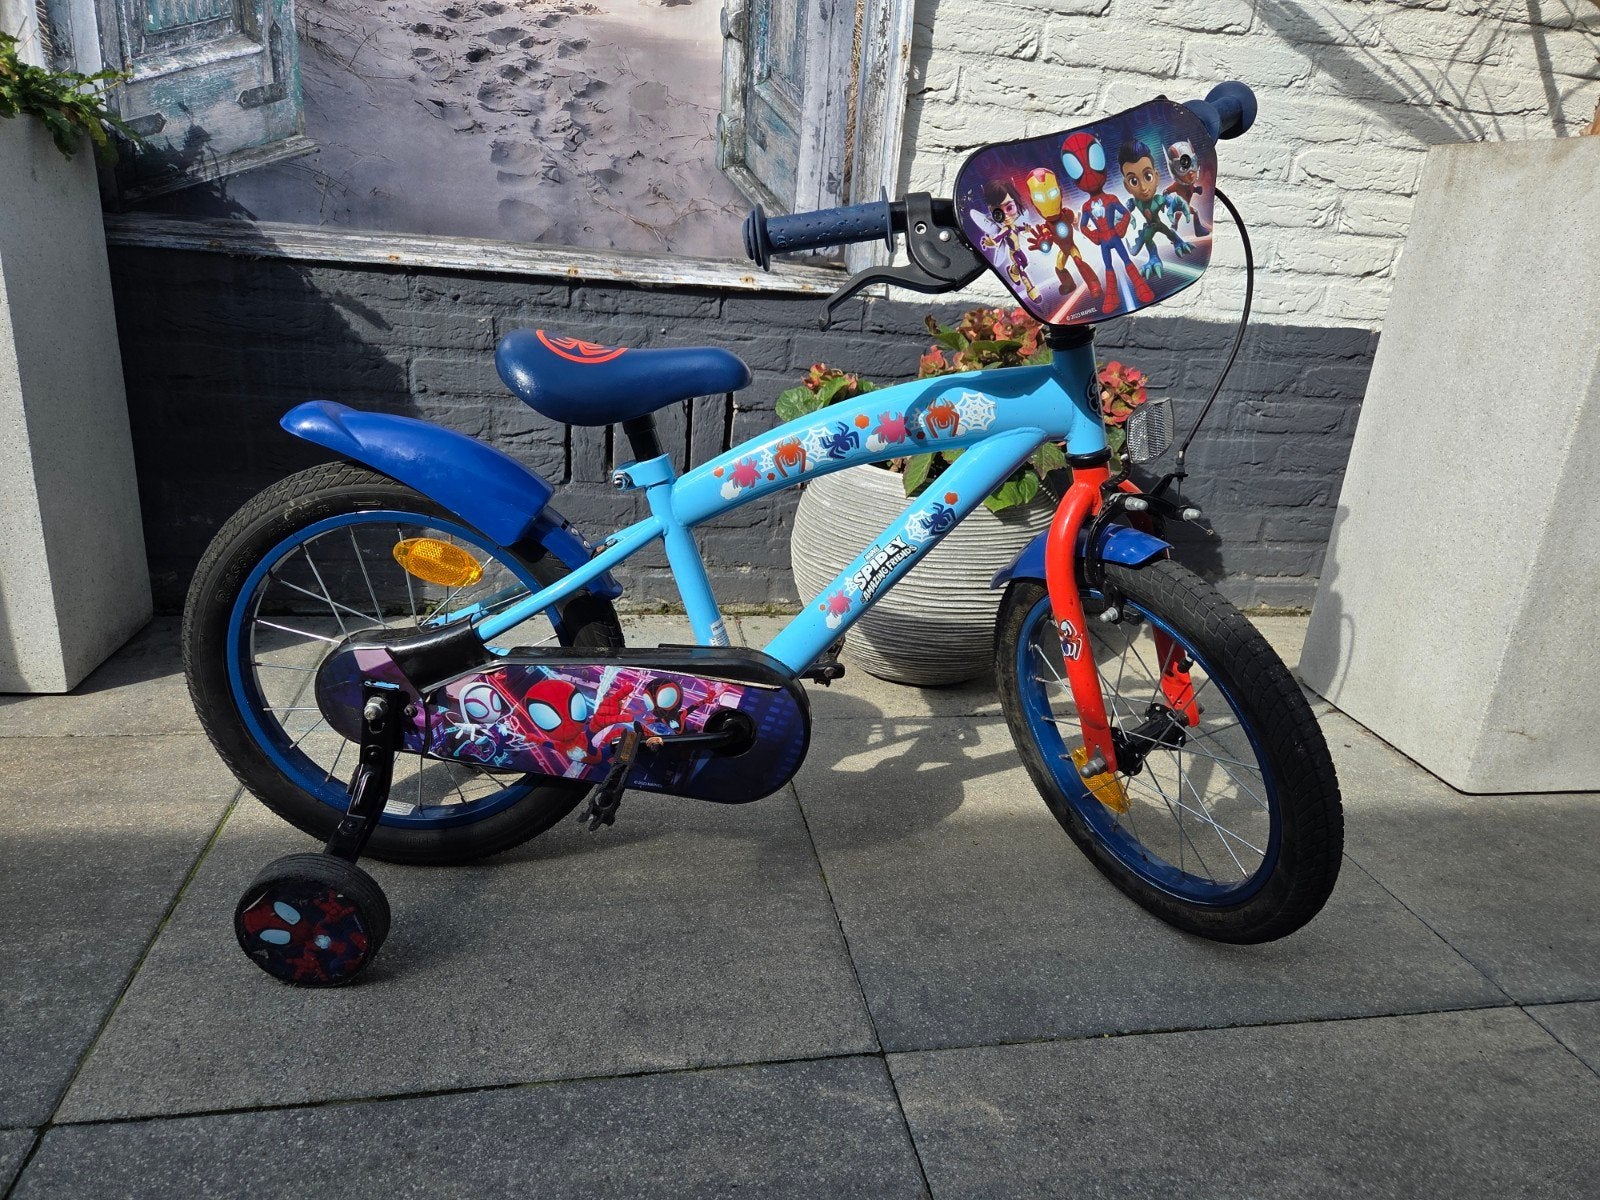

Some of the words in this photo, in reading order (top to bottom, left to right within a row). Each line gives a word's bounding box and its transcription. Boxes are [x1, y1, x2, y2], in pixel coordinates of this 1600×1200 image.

[853, 535, 907, 591] SPIDEY
[863, 566, 890, 604] AMAZING
[886, 545, 918, 572] FRIENDS
